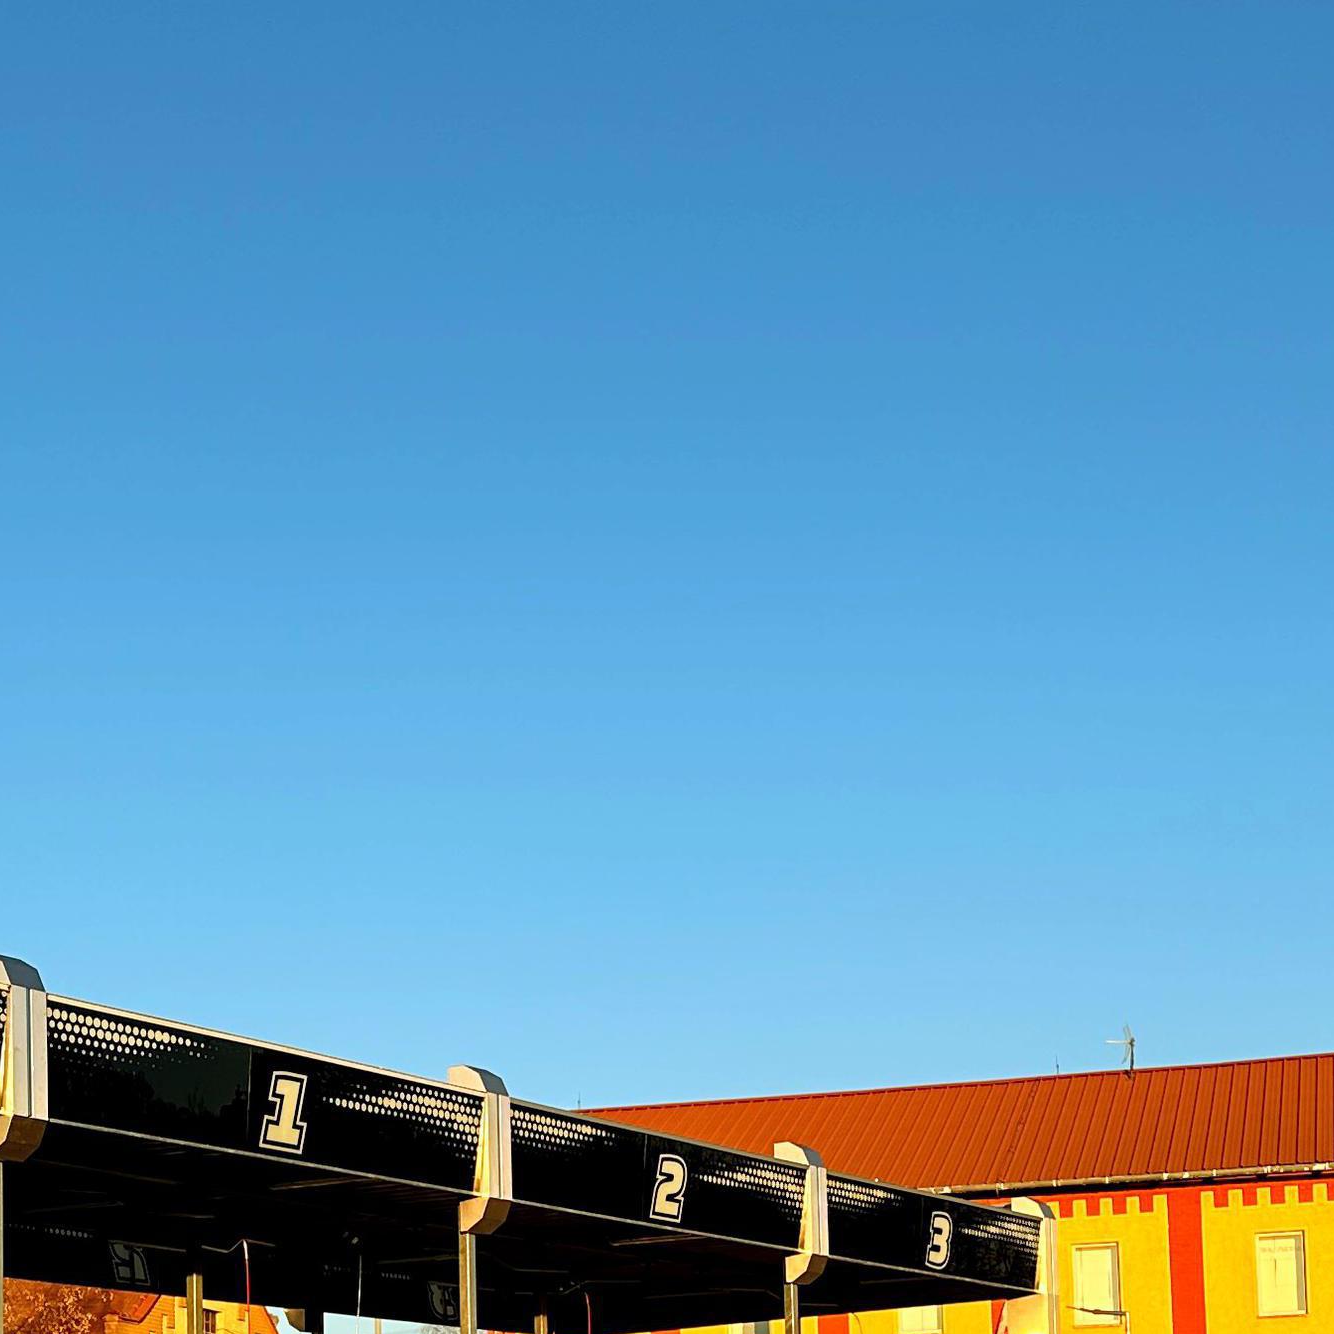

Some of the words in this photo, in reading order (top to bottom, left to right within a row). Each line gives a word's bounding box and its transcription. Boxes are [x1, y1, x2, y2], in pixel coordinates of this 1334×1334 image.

[259, 1071, 308, 1154] 1
[650, 1154, 688, 1223] 2
[925, 1211, 953, 1270] 3
